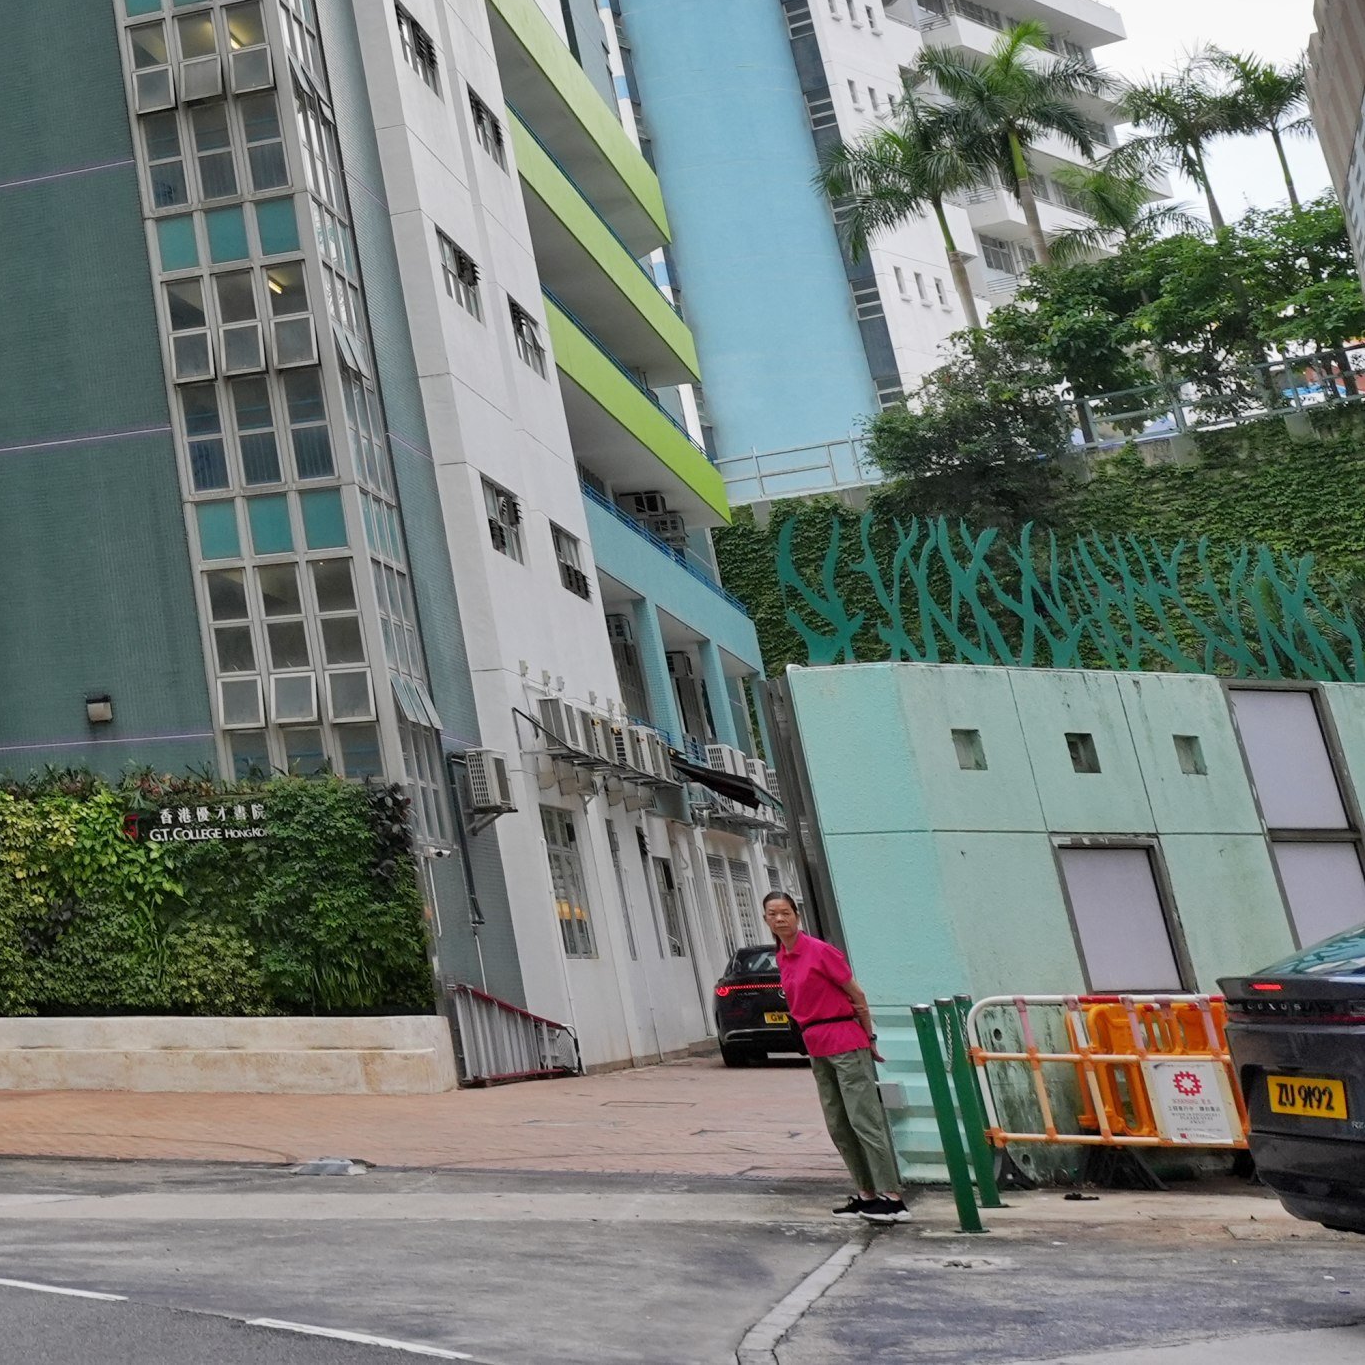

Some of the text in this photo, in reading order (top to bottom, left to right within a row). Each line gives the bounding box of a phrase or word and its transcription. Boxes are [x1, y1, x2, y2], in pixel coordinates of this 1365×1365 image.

[149, 829, 173, 842] G.T.
[172, 827, 224, 841] COLLEGE
[1276, 1082, 1296, 1108] ZU
